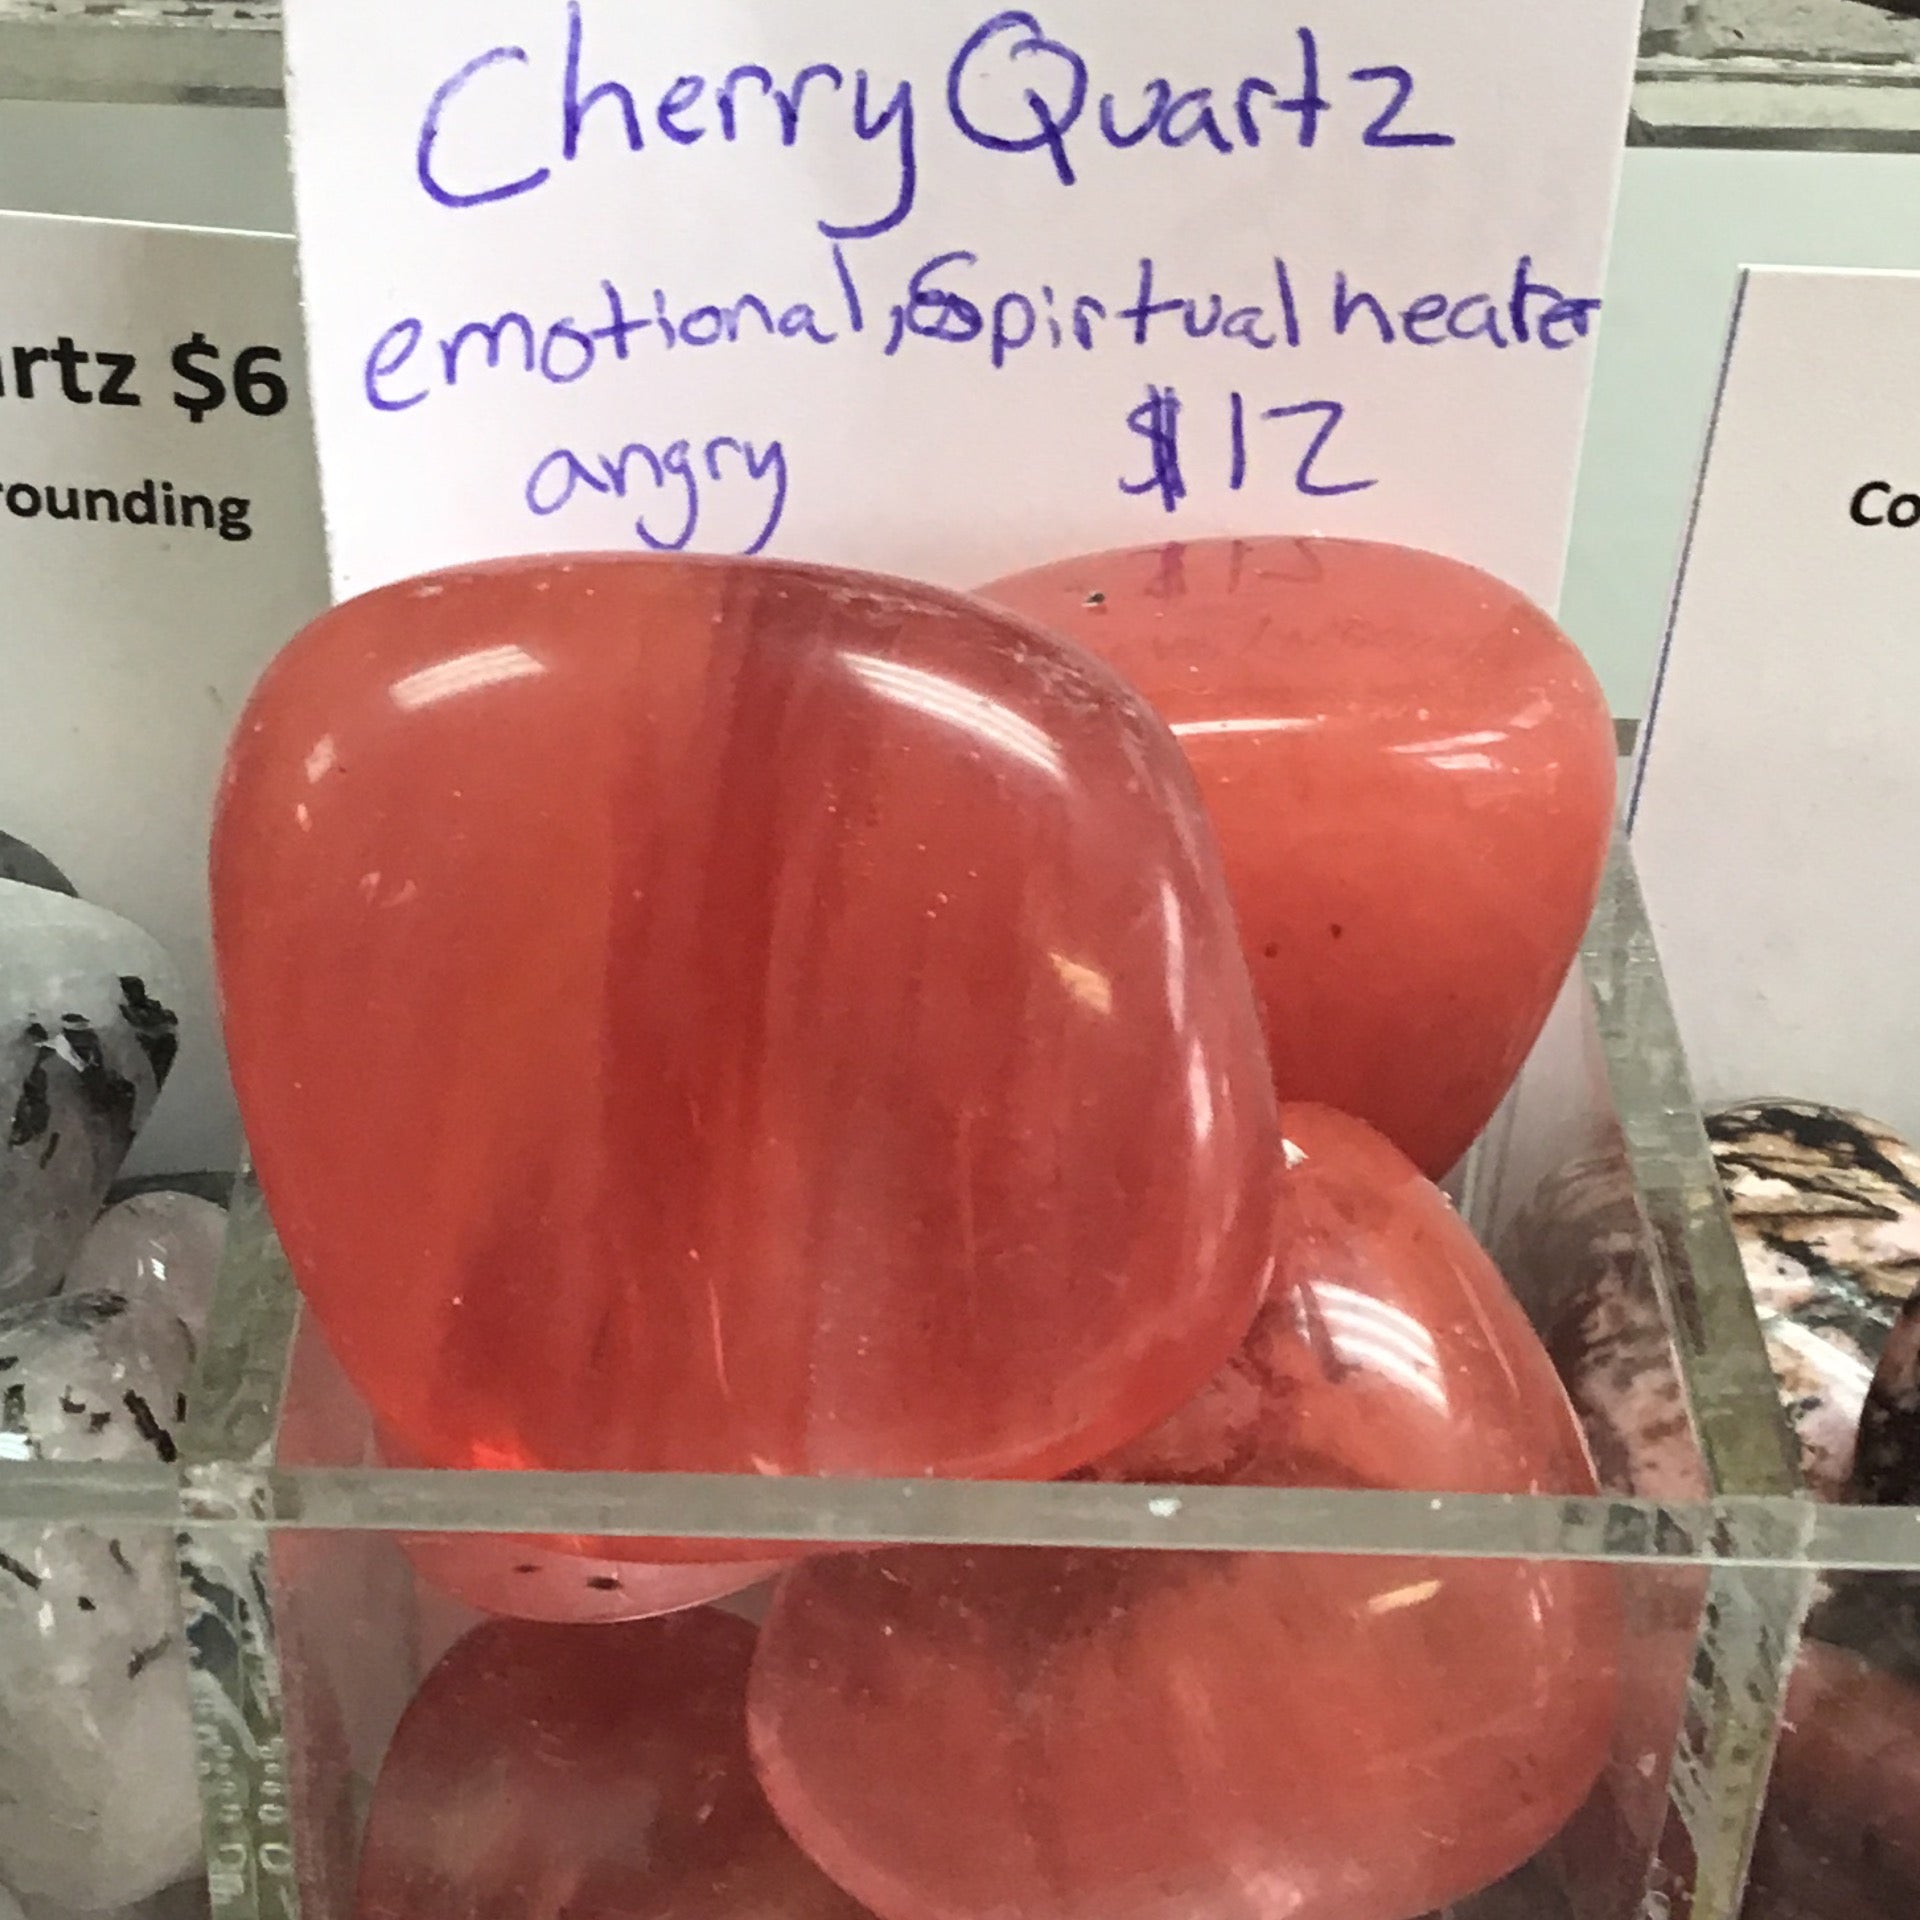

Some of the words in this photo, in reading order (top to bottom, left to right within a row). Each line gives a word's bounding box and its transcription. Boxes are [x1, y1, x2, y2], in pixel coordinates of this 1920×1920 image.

[416, 1, 916, 239] Cherry
[947, 10, 1454, 186] Quartz
[0, 336, 142, 407] rtz
[171, 331, 289, 423] $6
[525, 436, 788, 556] angry
[1119, 386, 1379, 512] $12
[0, 478, 252, 541] ounding
